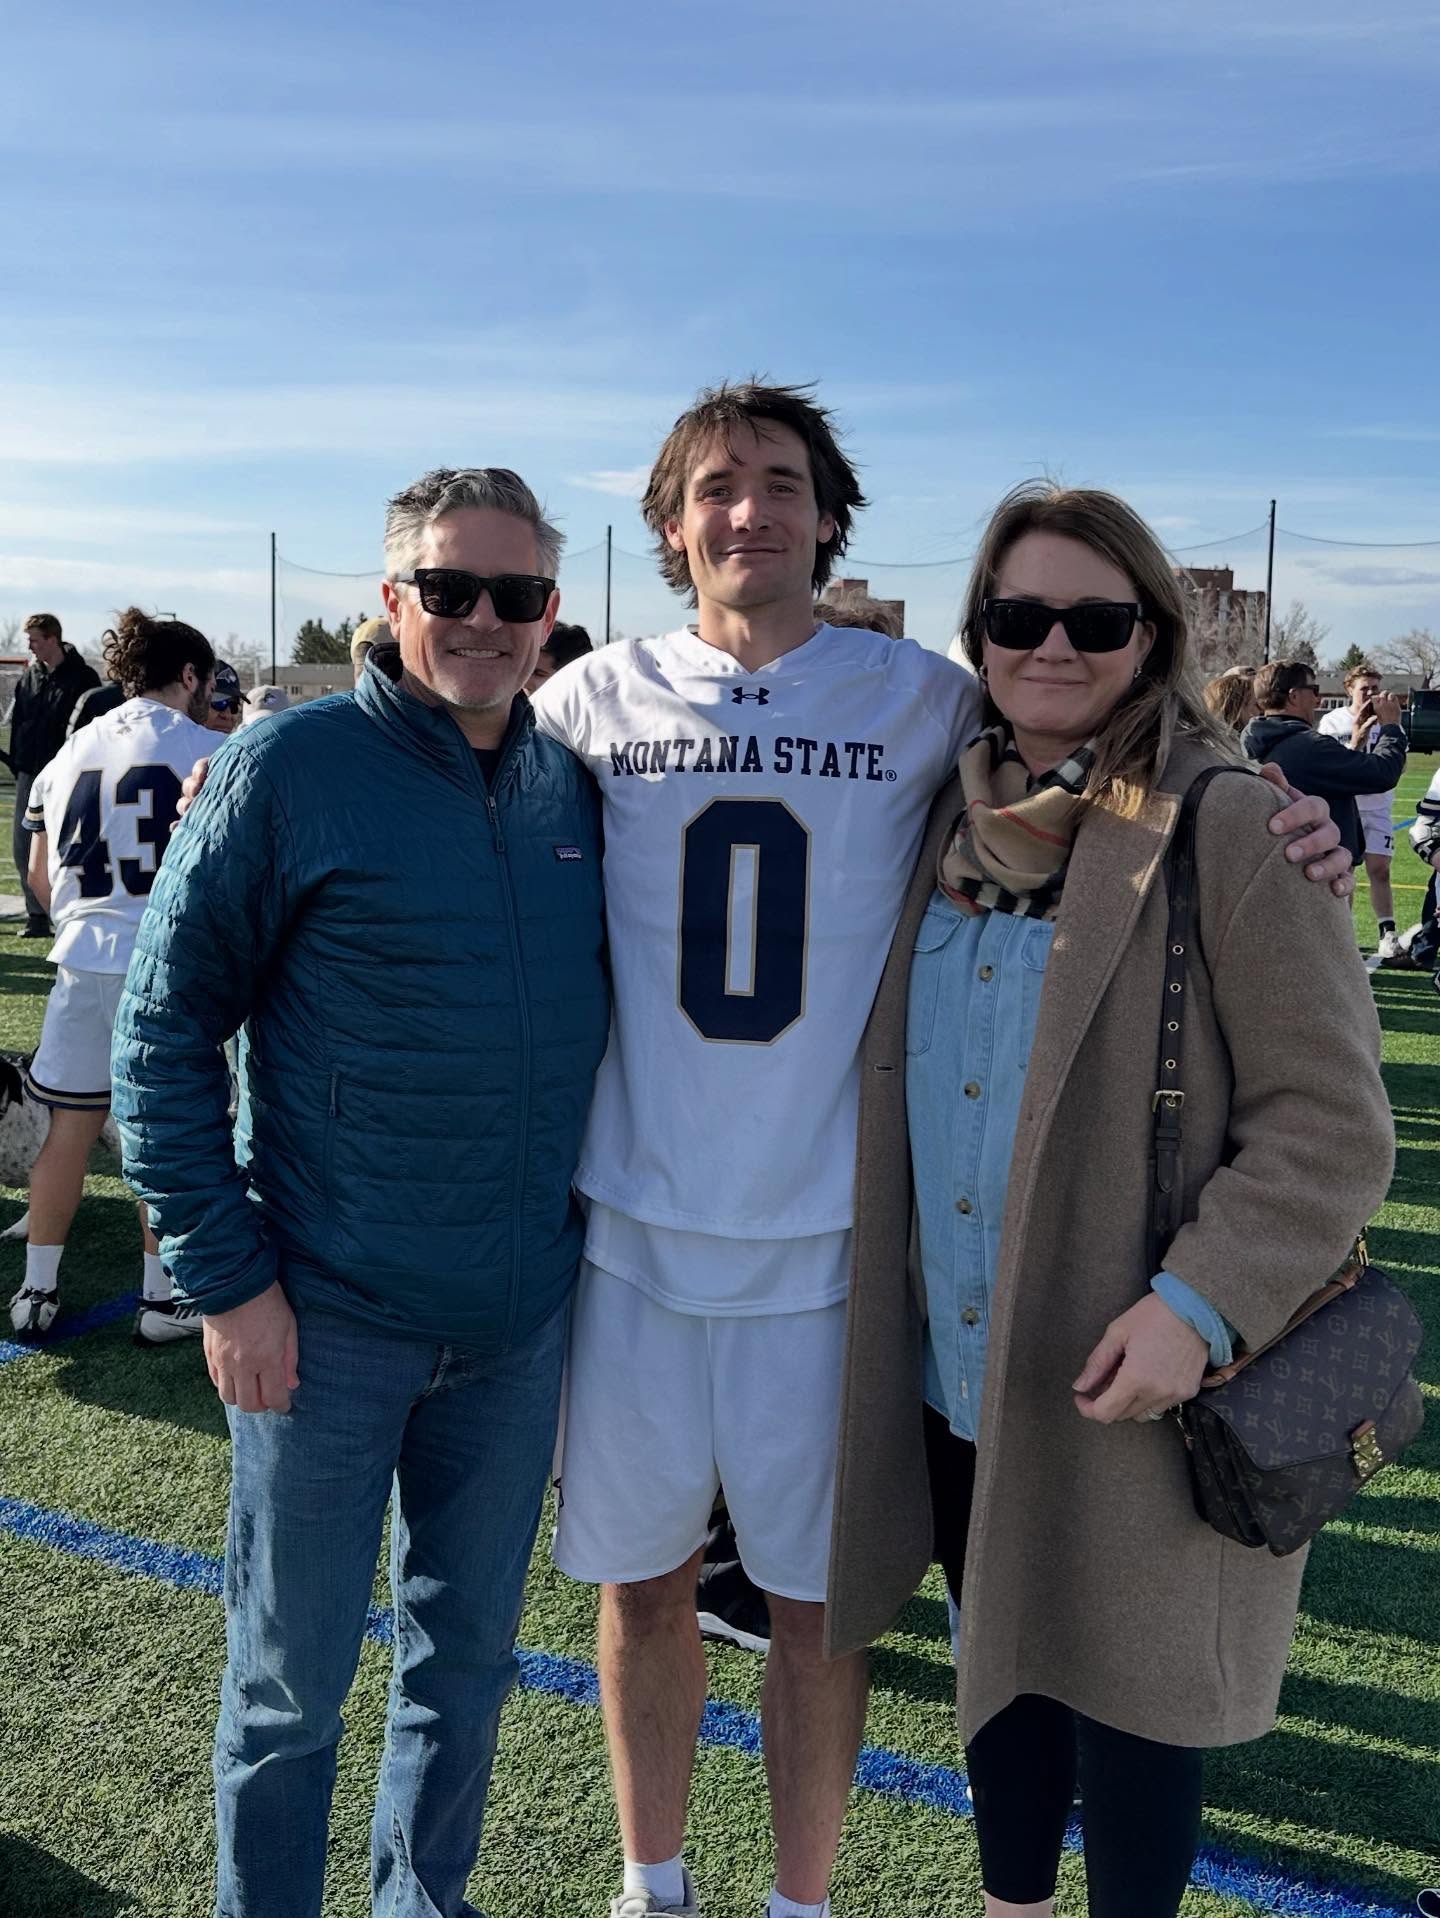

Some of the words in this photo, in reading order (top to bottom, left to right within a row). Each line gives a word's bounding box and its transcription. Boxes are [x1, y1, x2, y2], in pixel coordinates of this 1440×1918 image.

[610, 736, 763, 776] MONTANA
[56, 763, 182, 897] 43
[676, 795, 812, 1047] 0
